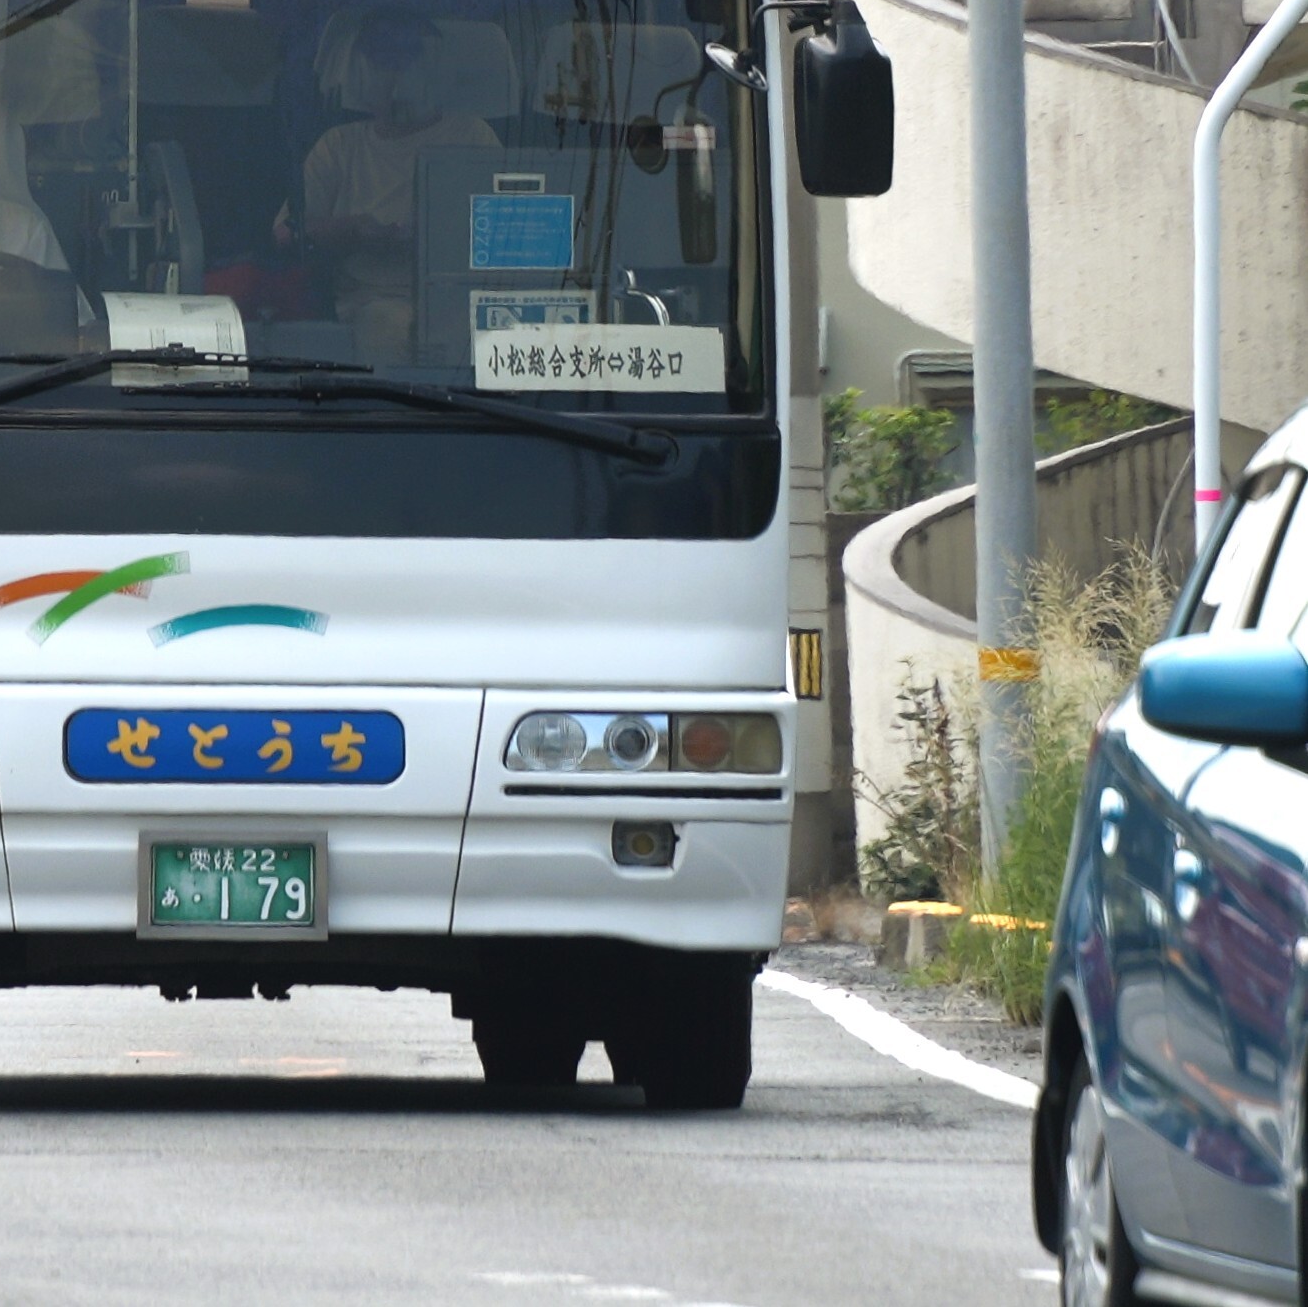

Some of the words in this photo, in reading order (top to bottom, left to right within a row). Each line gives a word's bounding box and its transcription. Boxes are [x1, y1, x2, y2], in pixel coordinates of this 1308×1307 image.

[487, 344, 606, 379] 小松総合支所
[627, 345, 684, 380] 湯谷口
[105, 717, 368, 773] せとうち
[161, 886, 180, 909] あ
